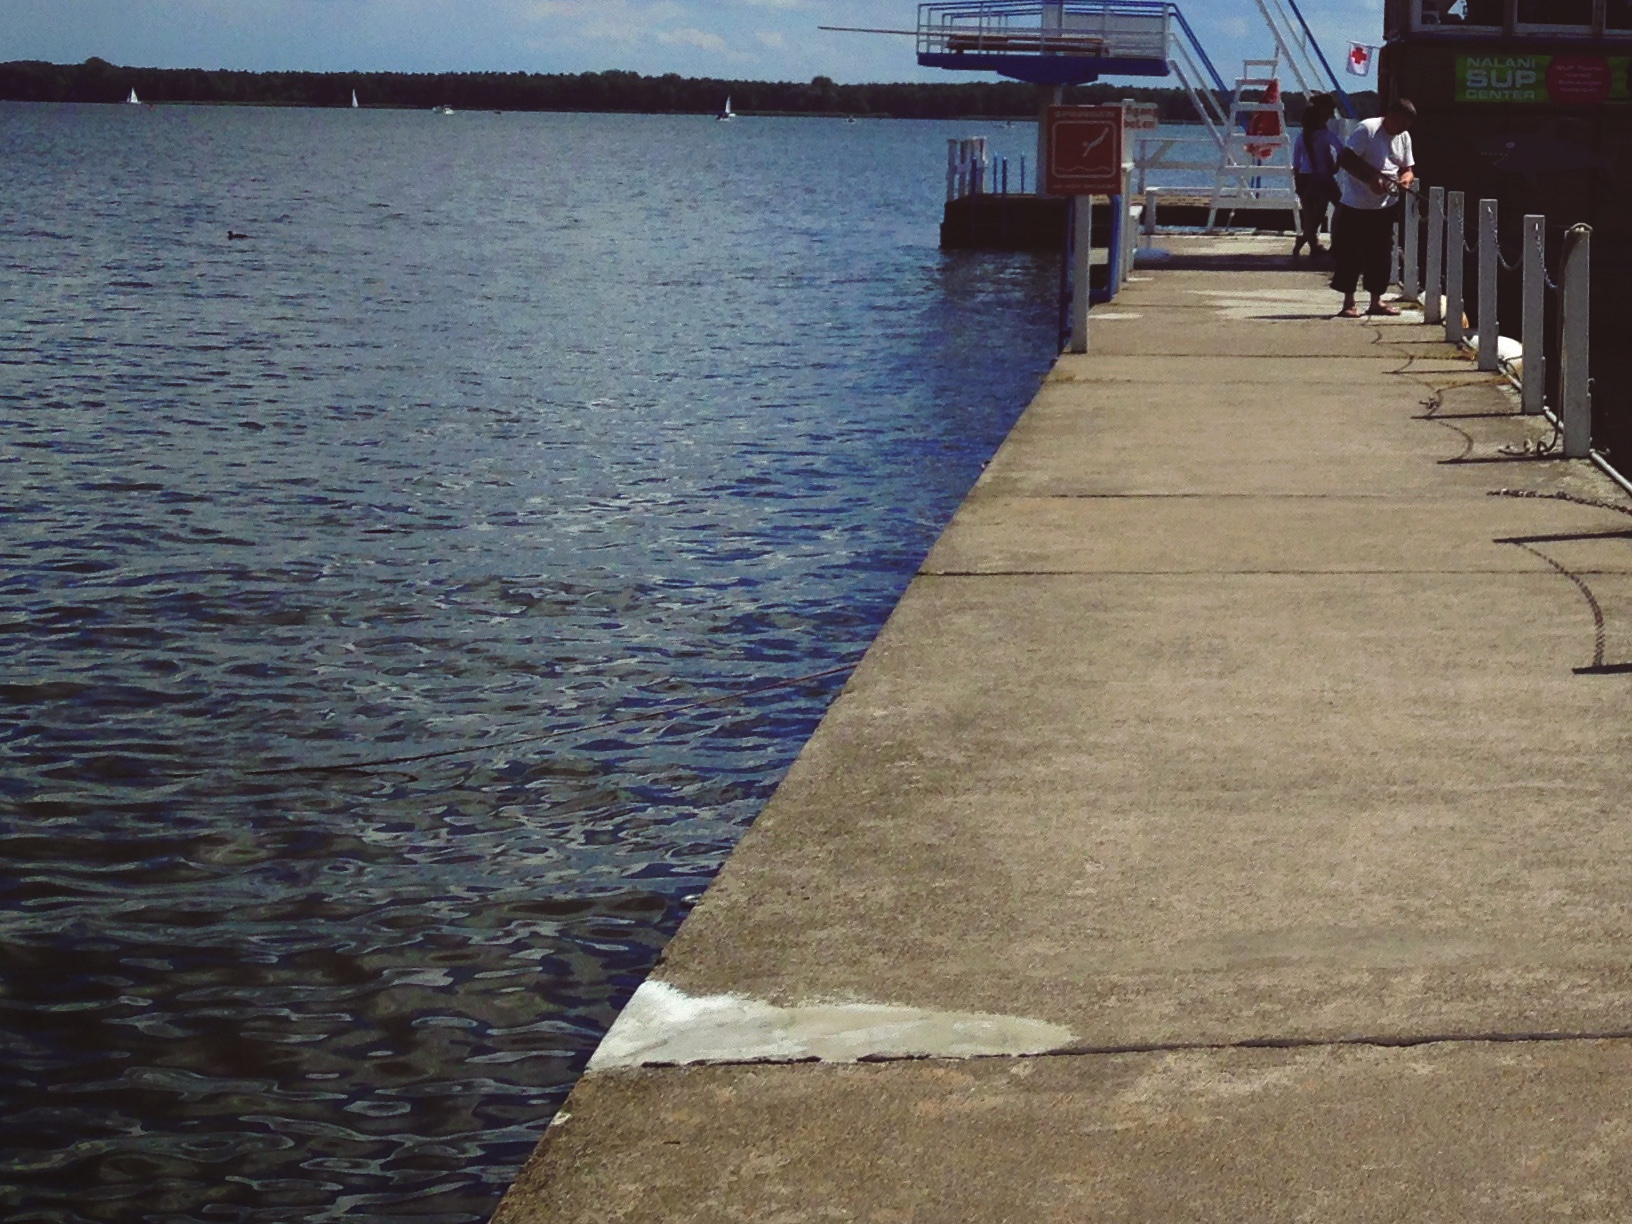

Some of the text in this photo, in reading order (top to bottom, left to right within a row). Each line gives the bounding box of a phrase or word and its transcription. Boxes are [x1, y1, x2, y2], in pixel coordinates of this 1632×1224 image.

[1466, 57, 1536, 68] NALANI
[1466, 69, 1537, 88] SUP
[1465, 89, 1535, 100] CENTER
